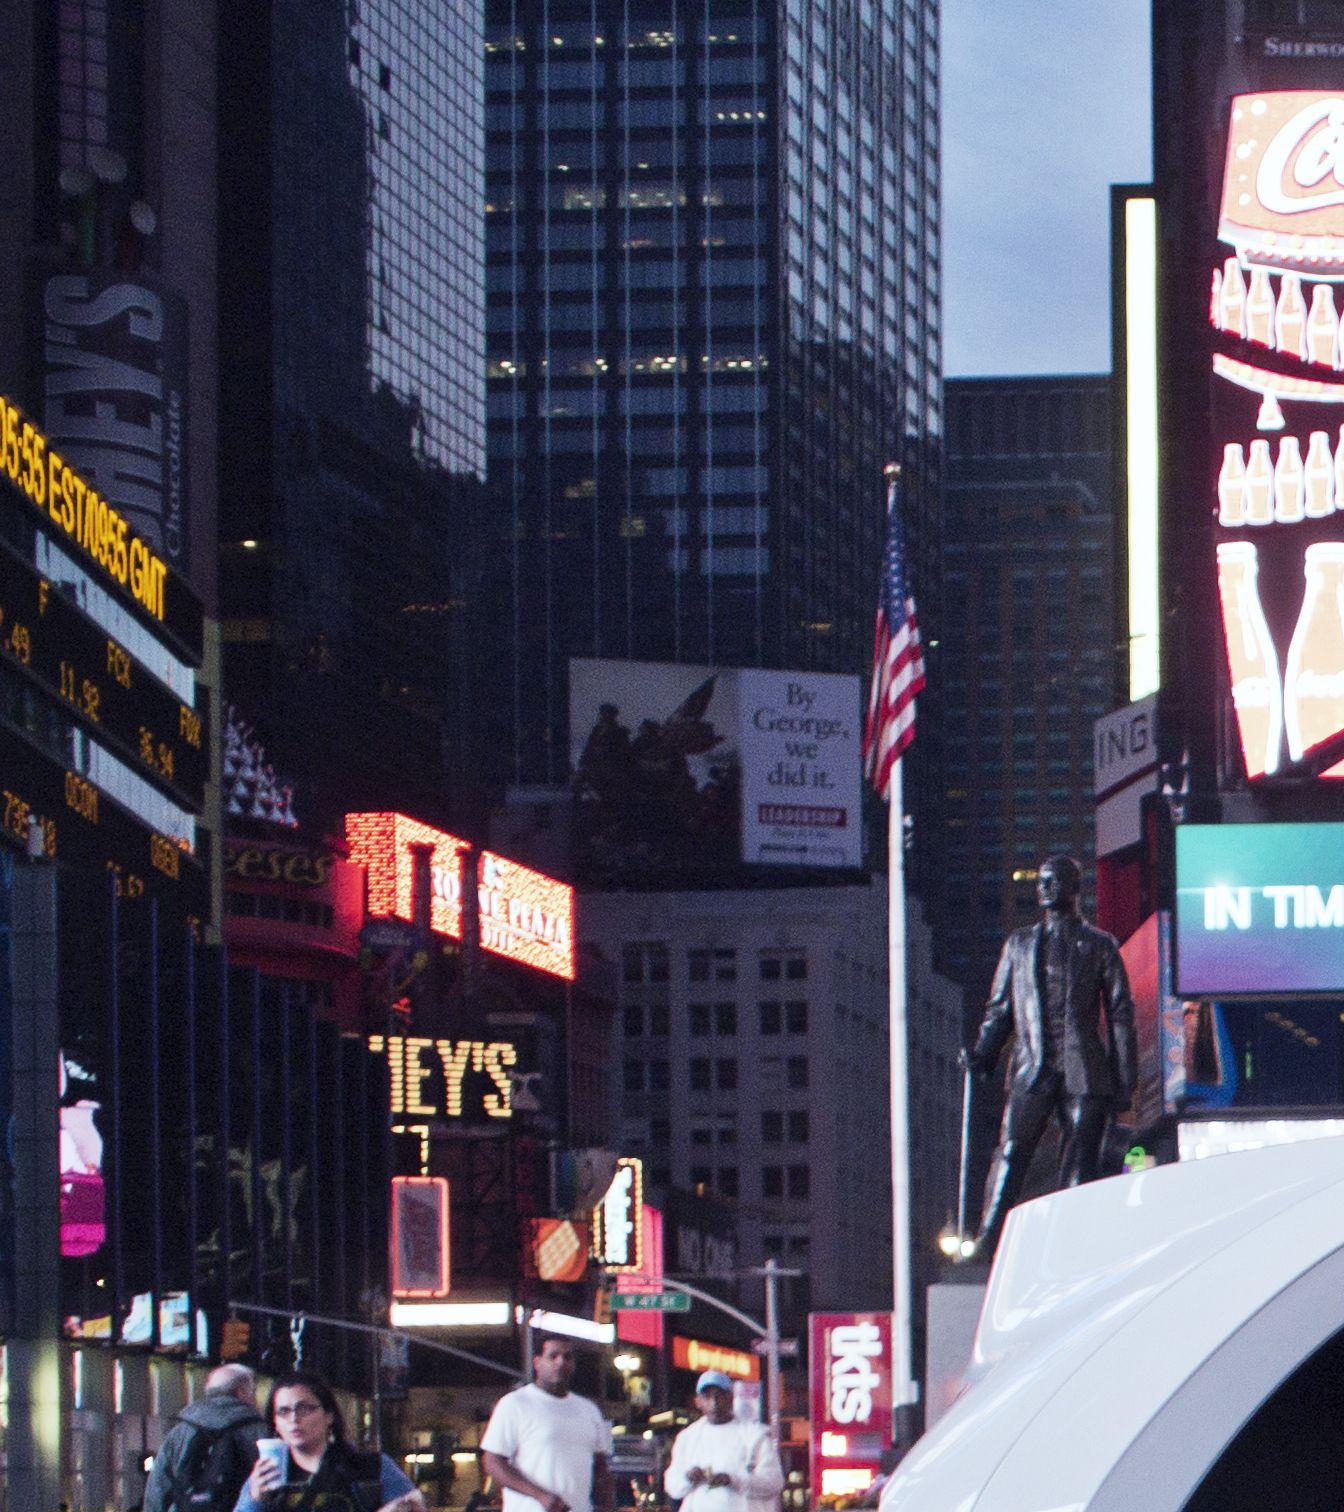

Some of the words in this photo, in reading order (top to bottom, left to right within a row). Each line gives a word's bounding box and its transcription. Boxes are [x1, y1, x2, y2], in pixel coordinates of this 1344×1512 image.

[129, 537, 167, 621] GMT
[1203, 884, 1252, 931] IN
[831, 1321, 883, 1425] tkts
